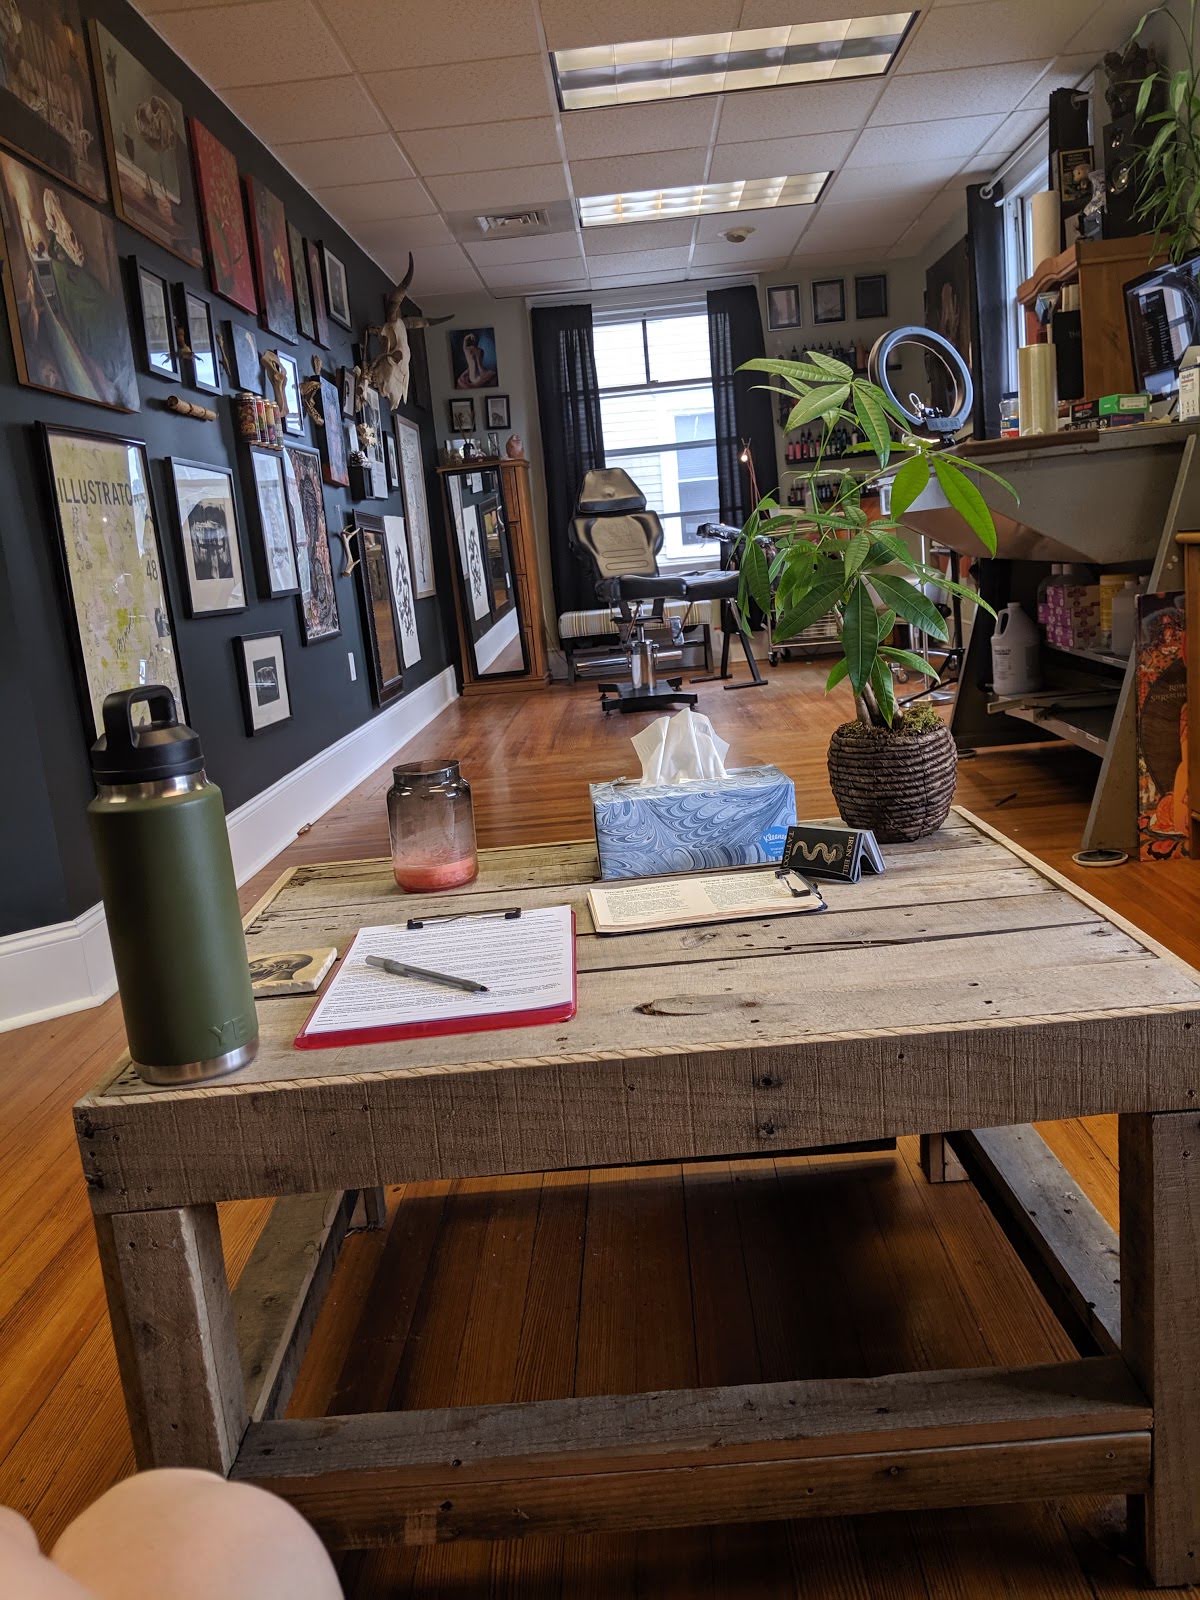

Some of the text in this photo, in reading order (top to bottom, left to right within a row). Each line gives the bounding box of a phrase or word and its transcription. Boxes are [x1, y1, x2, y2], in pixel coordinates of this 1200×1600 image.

[146, 559, 158, 581] 48
[783, 830, 795, 868] TATTOO
[846, 836, 855, 857] IRON
[207, 1014, 250, 1047] YE
